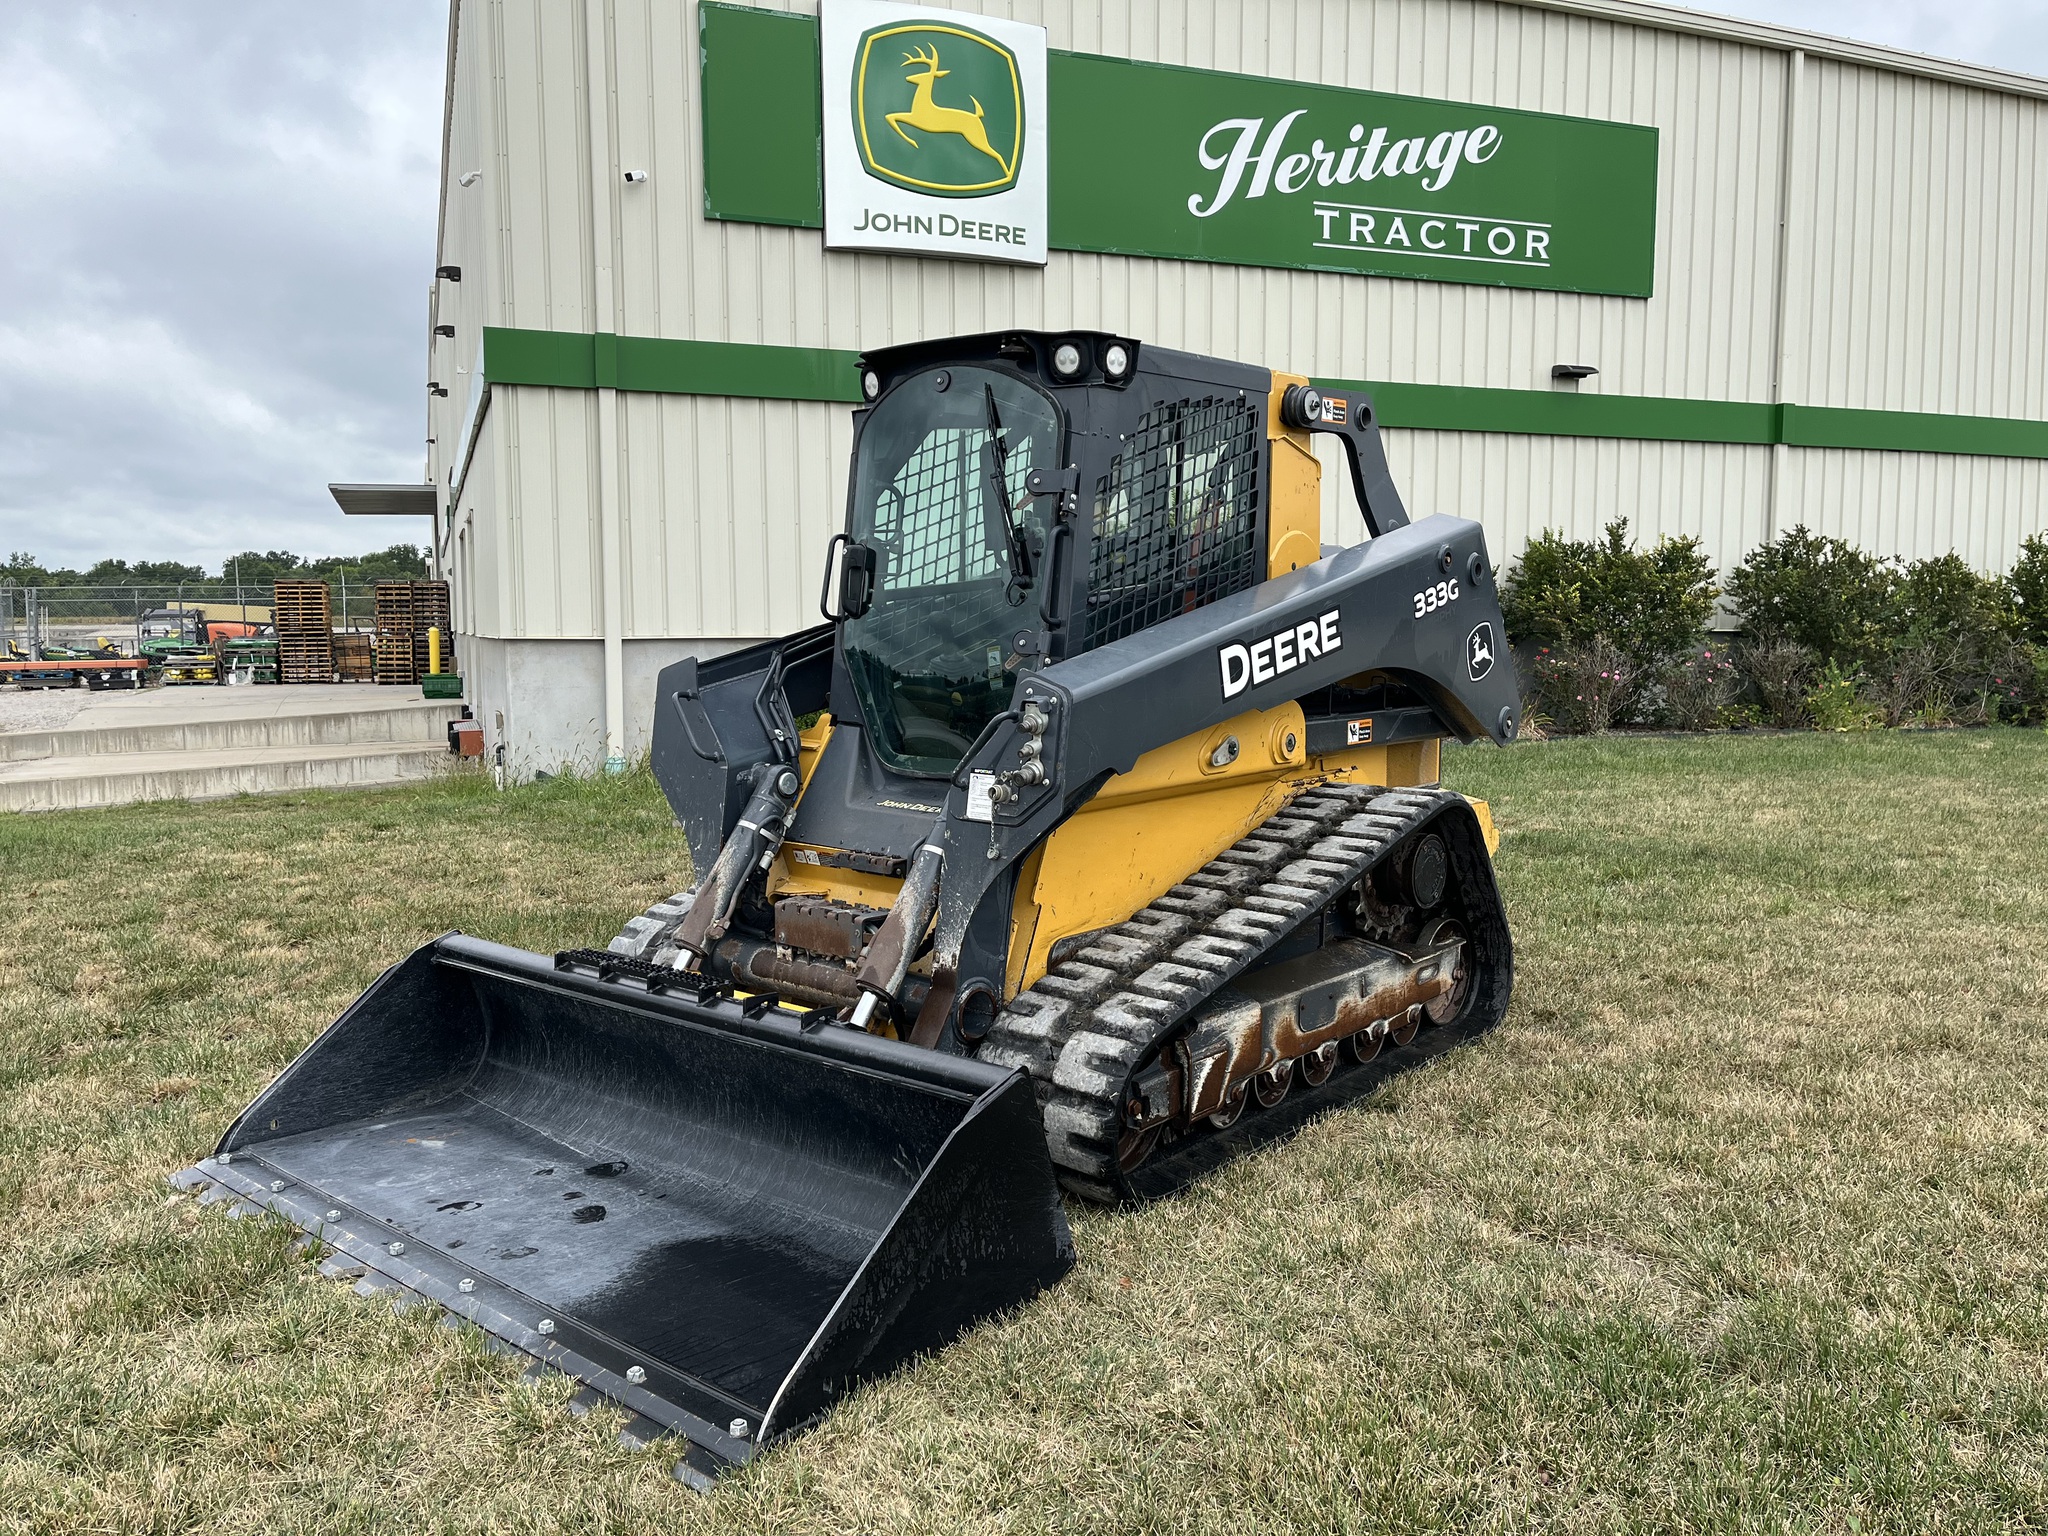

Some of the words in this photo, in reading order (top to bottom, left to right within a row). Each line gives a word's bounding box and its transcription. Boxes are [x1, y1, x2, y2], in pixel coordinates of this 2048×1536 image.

[1187, 109, 1503, 217] Heritage
[854, 208, 932, 235] JOHN
[938, 213, 1027, 246] DEERE
[1314, 208, 1550, 258] TRACTOR
[1413, 578, 1459, 618] 333G
[1220, 609, 1342, 699] DEERE
[876, 799, 912, 809] JOHN
